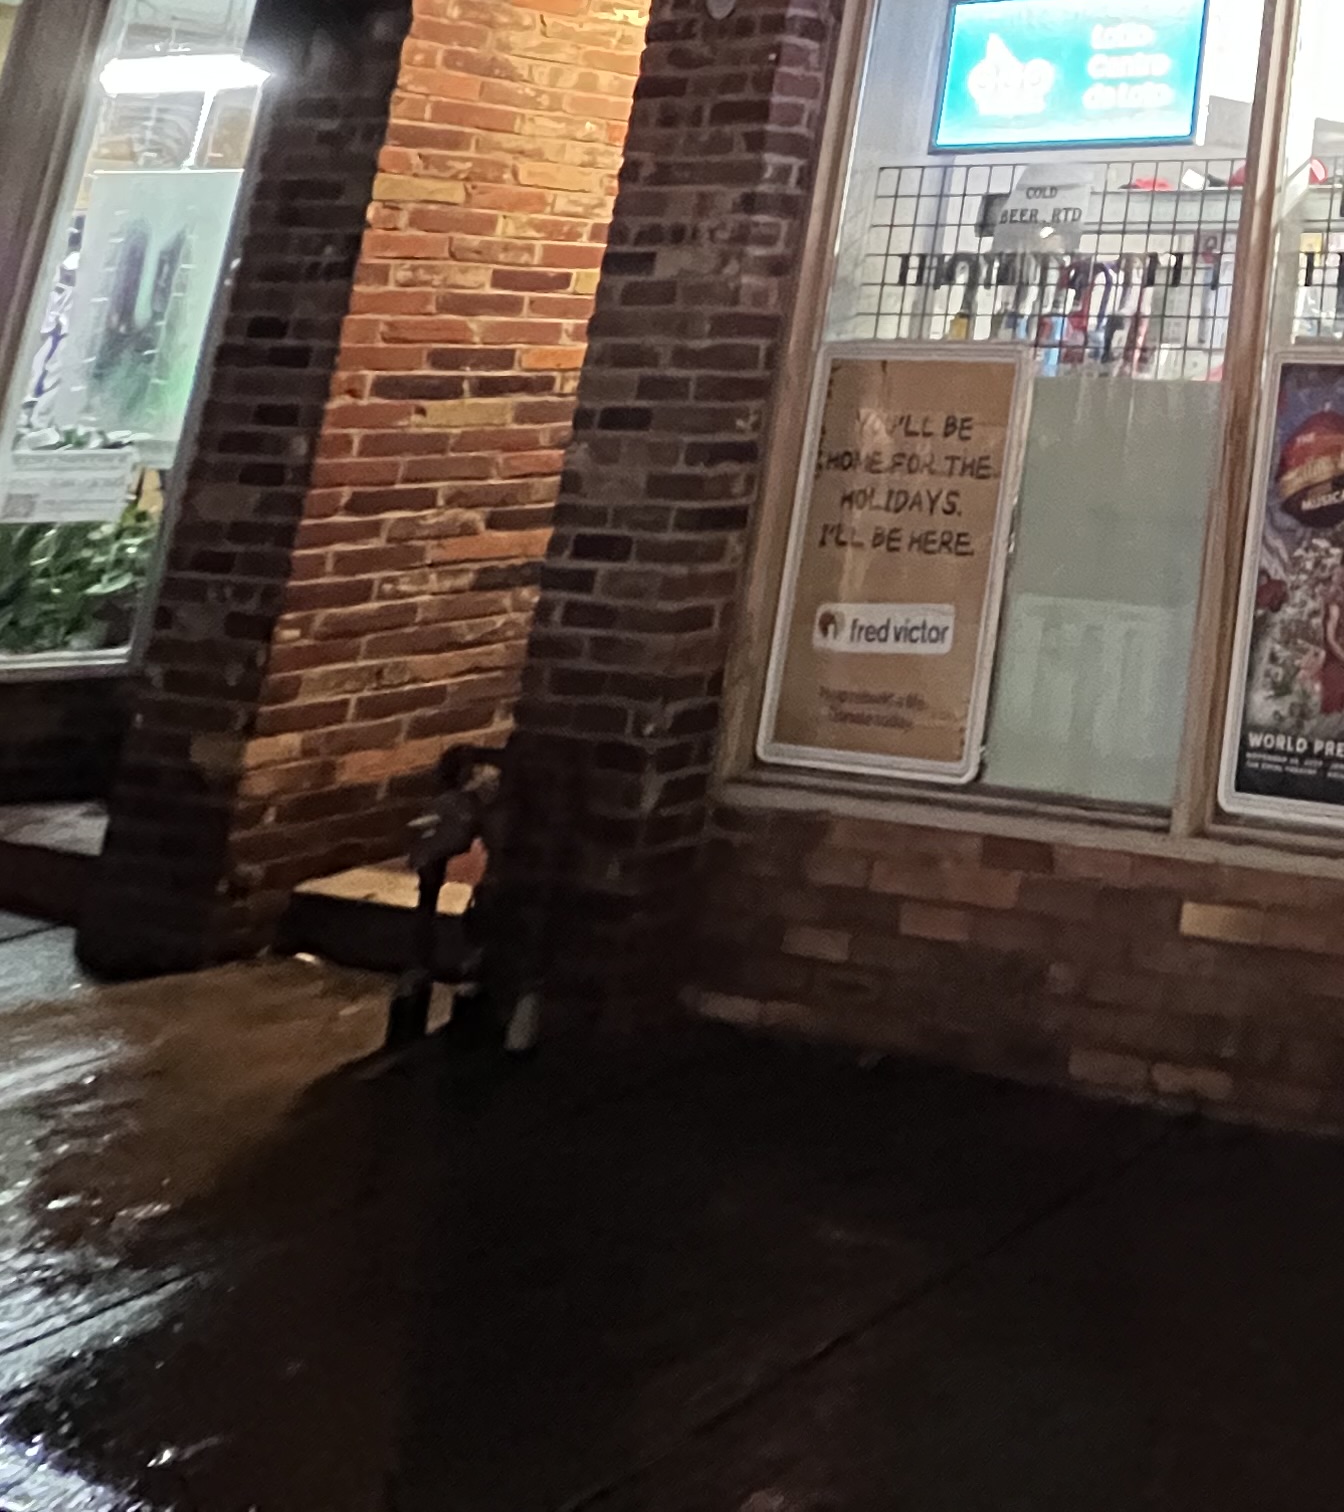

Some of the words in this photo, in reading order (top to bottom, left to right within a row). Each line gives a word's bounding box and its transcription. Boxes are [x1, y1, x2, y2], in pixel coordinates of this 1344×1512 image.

[1025, 185, 1058, 201] COLD
[1000, 207, 1040, 224] BEER
[1052, 208, 1083, 223] RTD
[943, 414, 974, 441] BE
[841, 486, 963, 517] HOLIDAYS.
[871, 526, 903, 553] BE
[849, 617, 890, 644] fred
[893, 618, 950, 645] victor
[1248, 732, 1309, 755] WORLD
